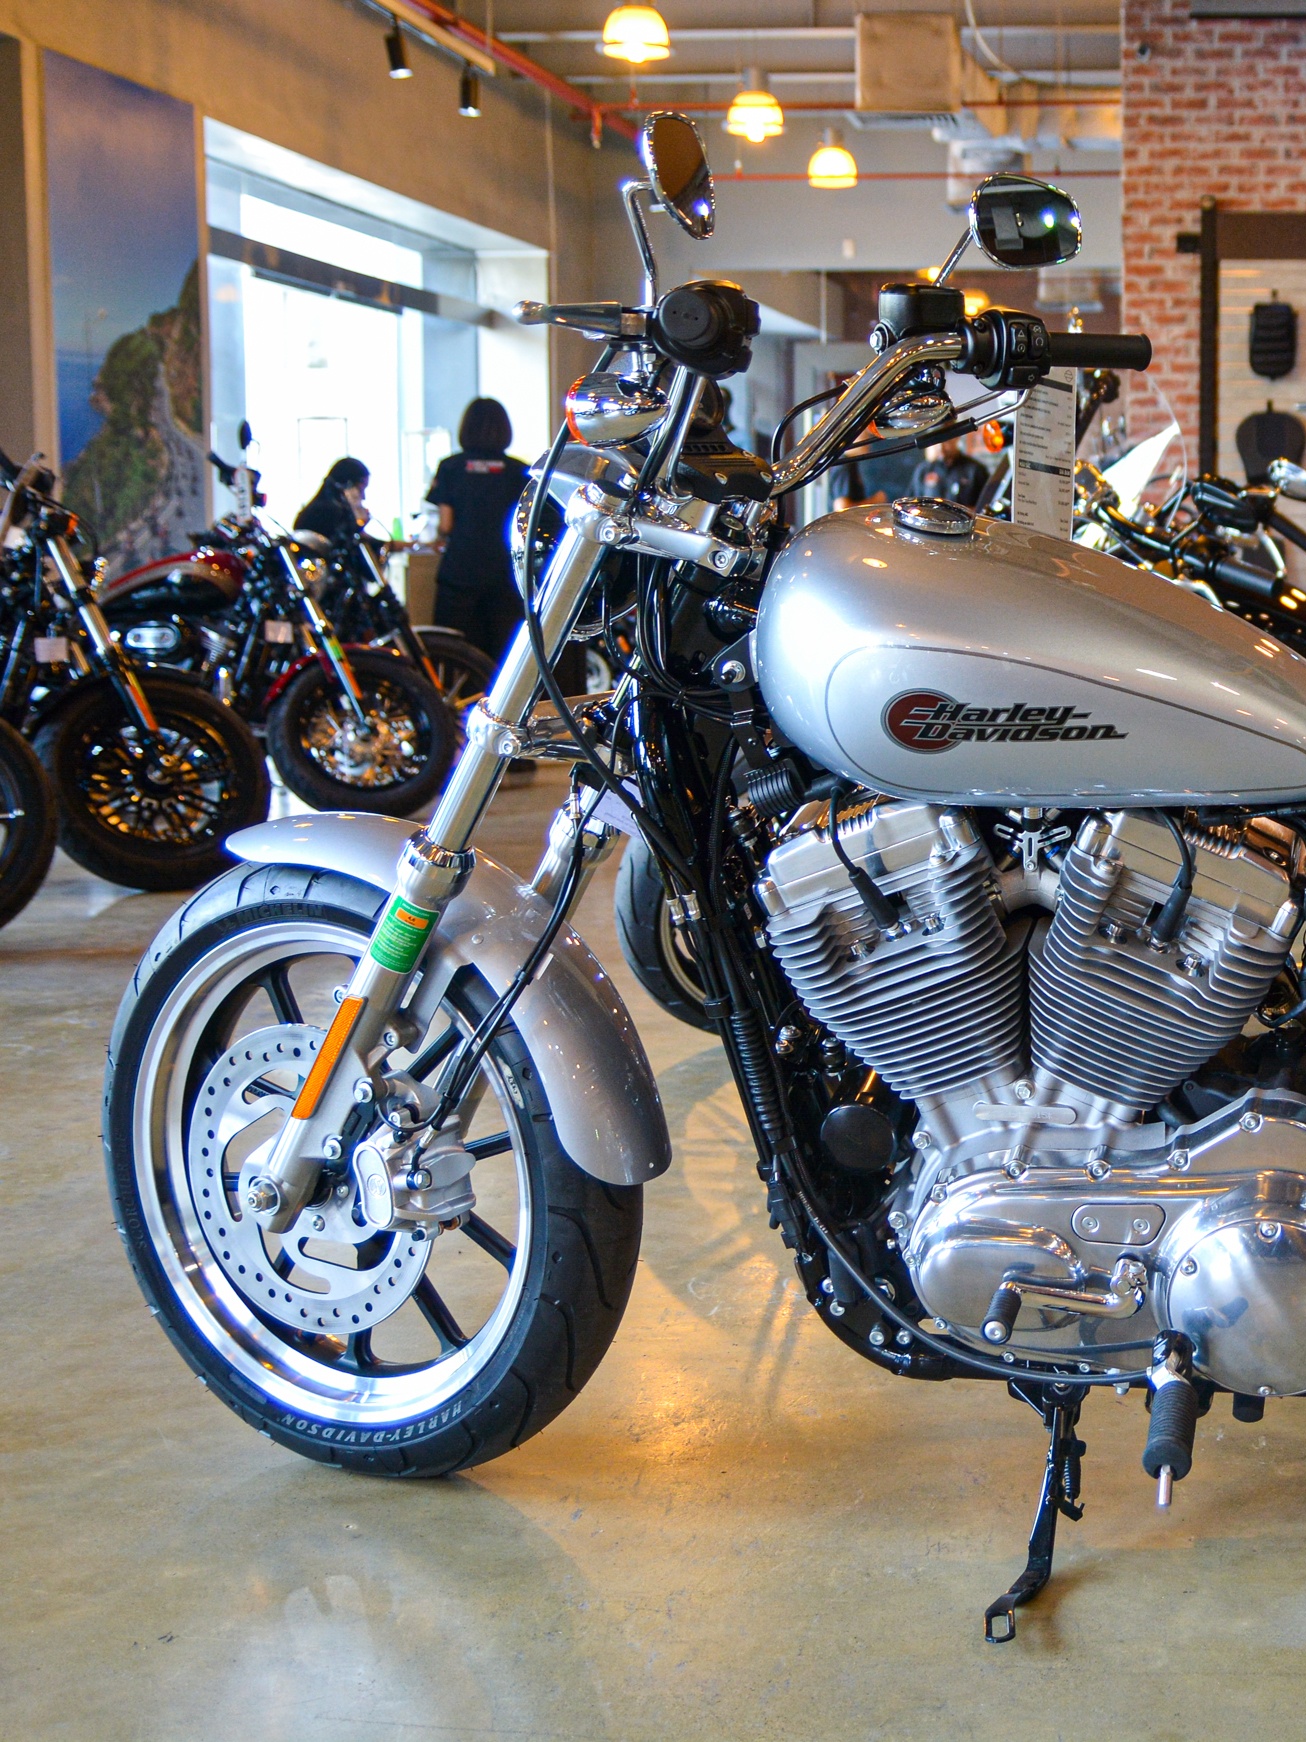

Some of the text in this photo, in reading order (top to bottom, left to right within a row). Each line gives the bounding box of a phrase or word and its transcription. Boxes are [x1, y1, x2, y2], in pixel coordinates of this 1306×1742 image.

[900, 720, 1130, 743] Davidson
[236, 902, 324, 922] MICHELIN
[279, 1400, 463, 1443] HARLEY-DAVIDSON
